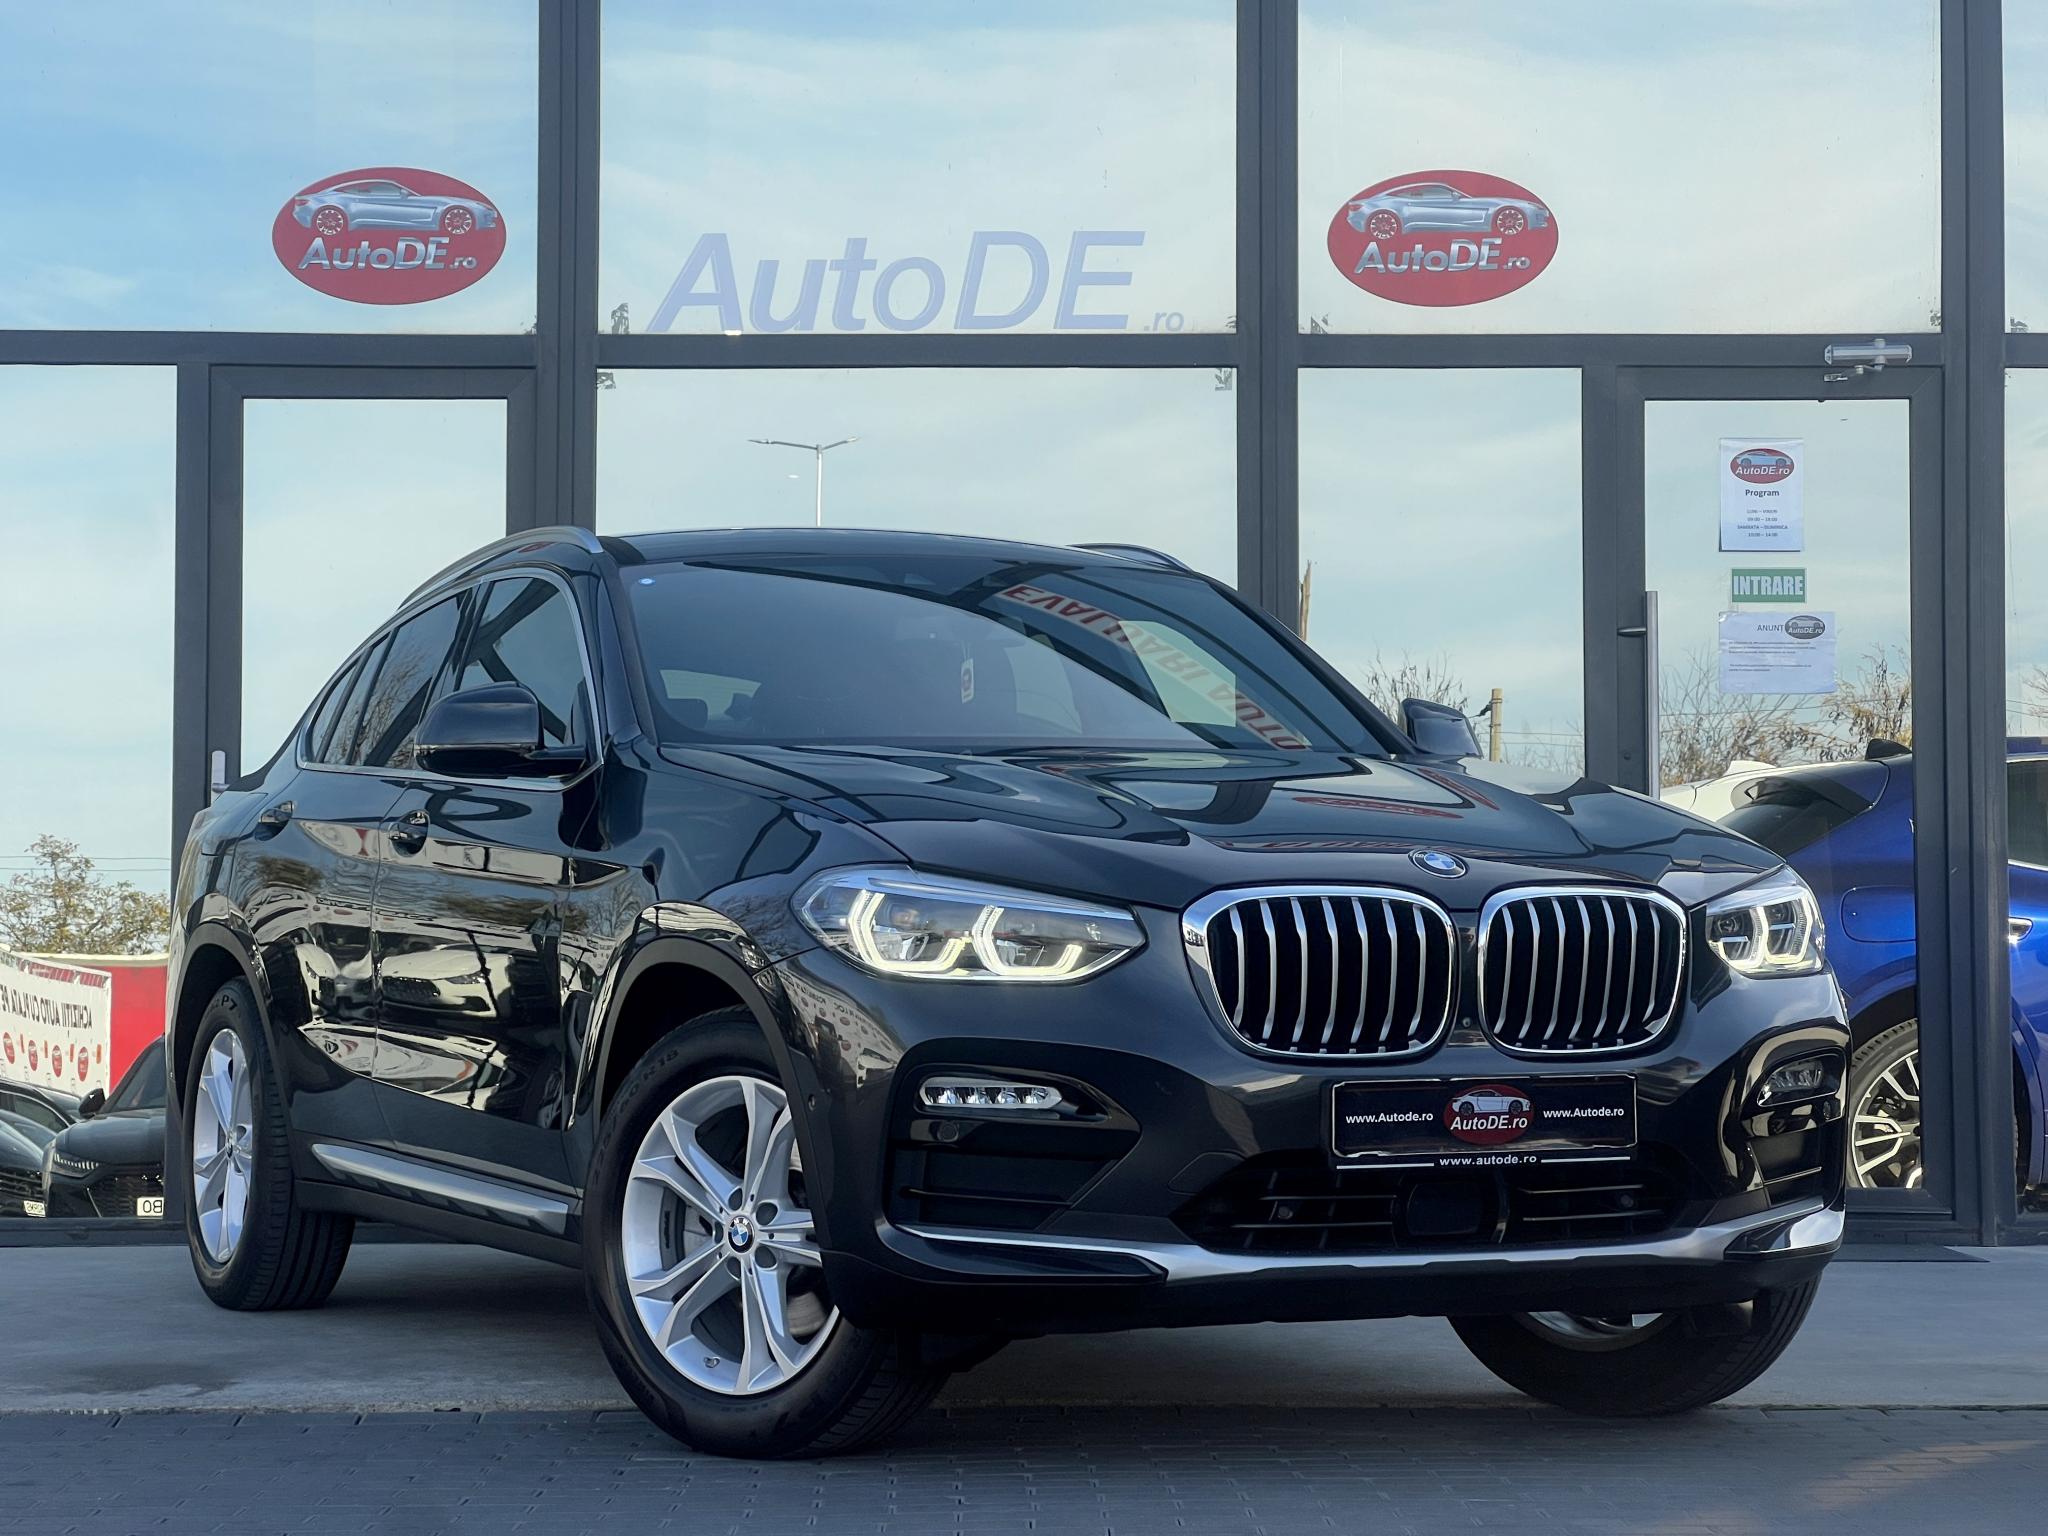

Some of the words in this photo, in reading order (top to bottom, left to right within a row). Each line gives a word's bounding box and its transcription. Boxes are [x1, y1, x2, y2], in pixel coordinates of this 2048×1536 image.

[1735, 466, 1790, 475] AutoDE.ro
[1745, 489, 1780, 498] Program
[1733, 575, 1804, 596] INTRARE
[1345, 1111, 1434, 1124] www.Autode.ro
[1543, 1107, 1625, 1119] www.Autode.ro
[1450, 1114, 1528, 1131] AutoDE.ro
[1439, 1154, 1537, 1166] www.autode.ro
